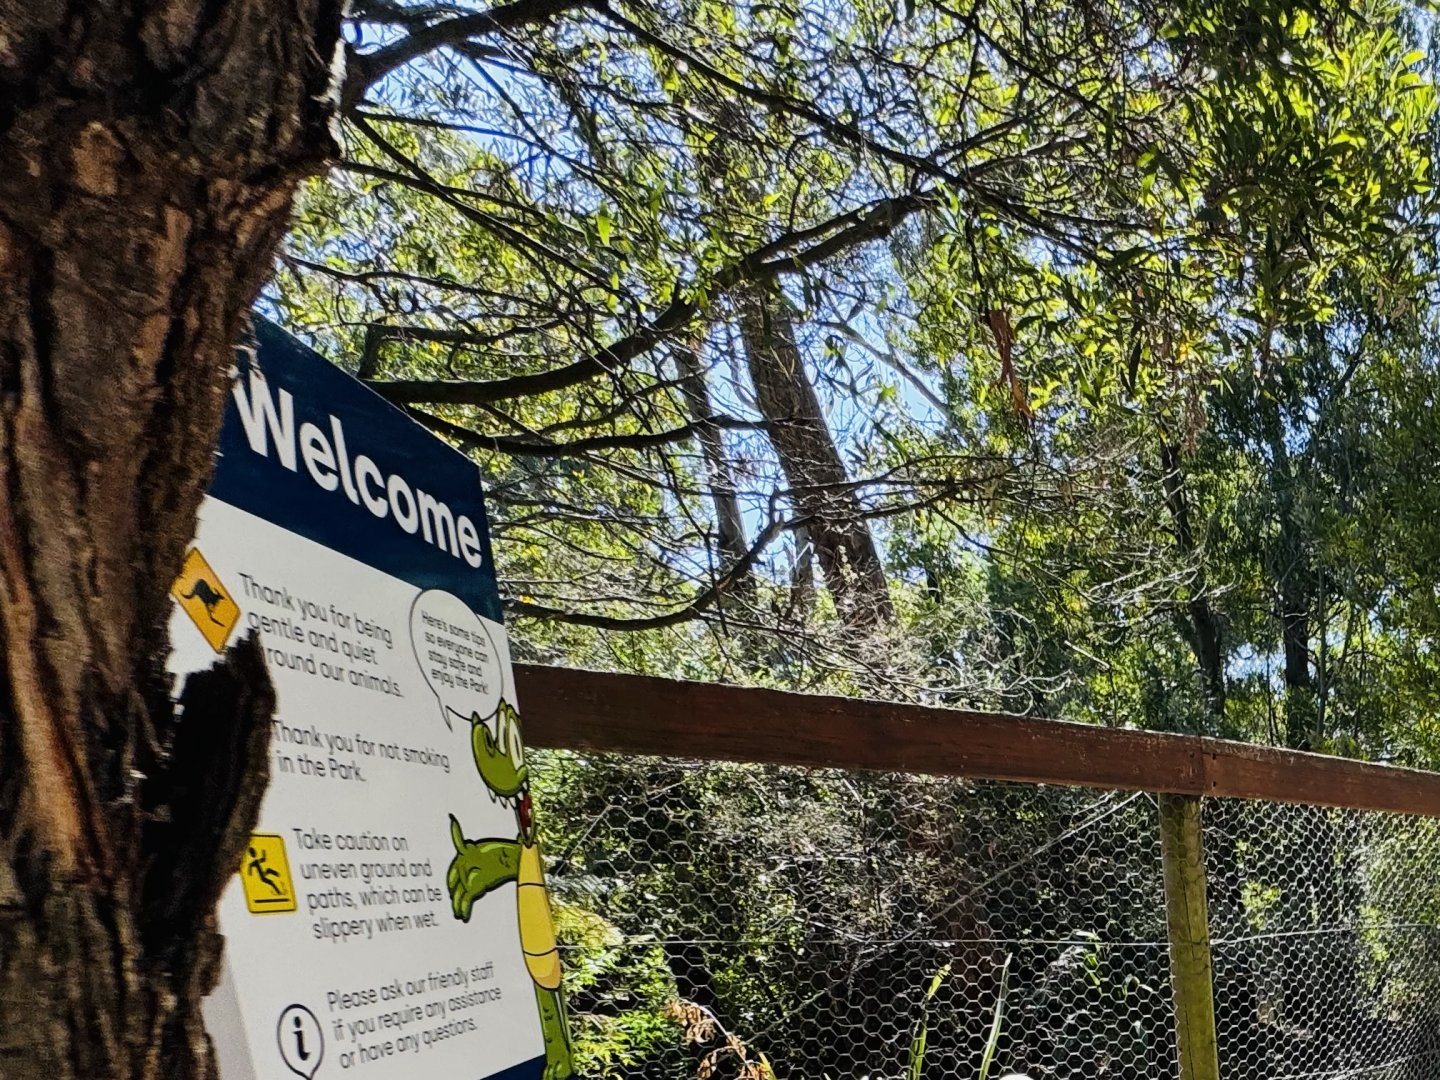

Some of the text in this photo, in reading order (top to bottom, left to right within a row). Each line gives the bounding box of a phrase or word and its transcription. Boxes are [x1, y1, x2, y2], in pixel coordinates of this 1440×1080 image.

[232, 369, 482, 569] Welcome
[238, 572, 393, 649] Thank you for being
[248, 612, 379, 665] gentle and quiet
[425, 631, 489, 664] so everyone can
[449, 623, 470, 641] some
[471, 631, 486, 648] tips
[266, 646, 405, 698] round our animals.
[428, 650, 482, 677] stay safe and
[431, 668, 454, 688] enjoy
[455, 673, 469, 689] the
[271, 718, 451, 774] Thank you for not smoking
[276, 750, 367, 782] in the Park.
[292, 828, 409, 851] Take caution on
[300, 857, 433, 884] uneven ground and
[306, 884, 443, 916] paths, which can be
[312, 910, 440, 944] slippery when wet.
[326, 961, 494, 1012] Please ask our friendly staff
[331, 985, 502, 1043] if you require any assistance
[339, 1016, 477, 1069] or have any questions.
